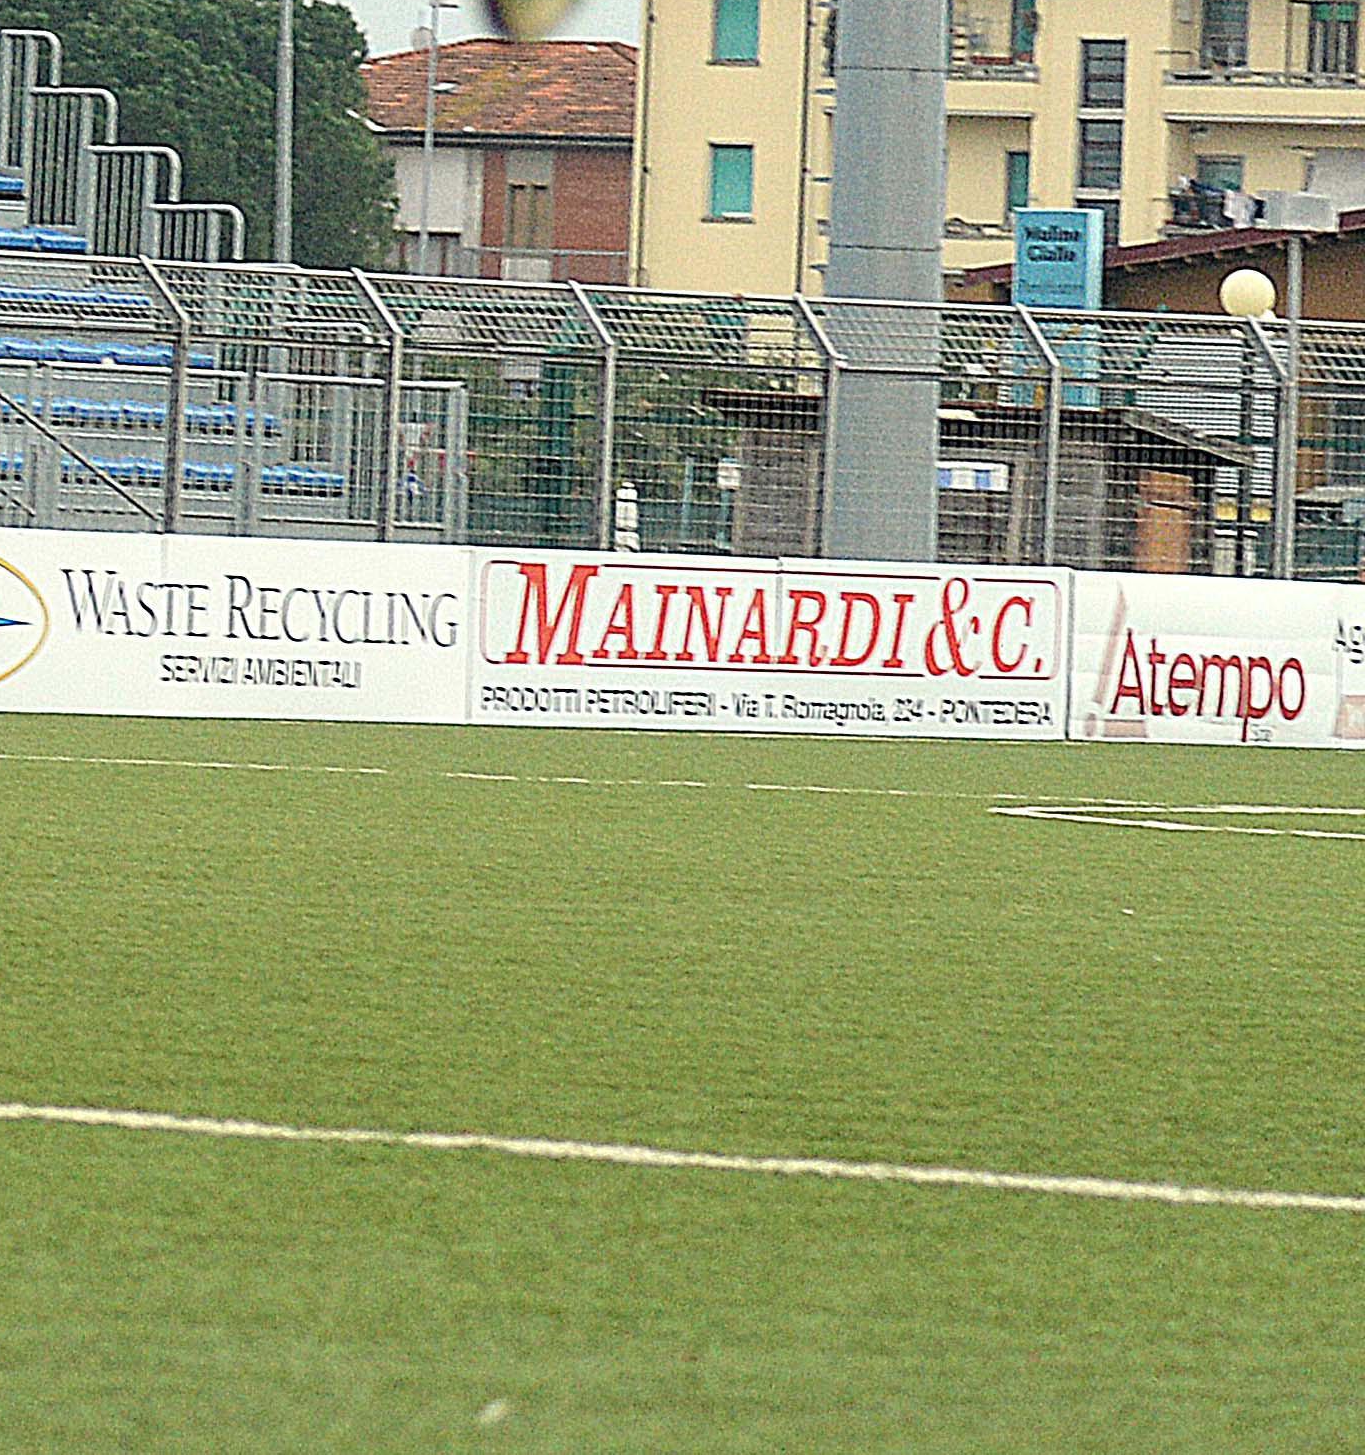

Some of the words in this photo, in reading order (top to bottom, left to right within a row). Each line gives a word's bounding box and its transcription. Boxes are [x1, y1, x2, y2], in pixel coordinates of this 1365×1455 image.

[61, 568, 211, 638] WASTE
[224, 574, 460, 647] RECYCLING
[505, 562, 916, 669] MAINARDI
[160, 654, 239, 685] SERVIZI
[242, 657, 362, 688] AMBIENTALI
[482, 685, 581, 712] PRODOTTI
[586, 688, 716, 718] PETROLIFERI
[732, 692, 759, 718] Via
[941, 699, 1054, 725] PONTEDERA
[1110, 627, 1305, 742] Atempo
